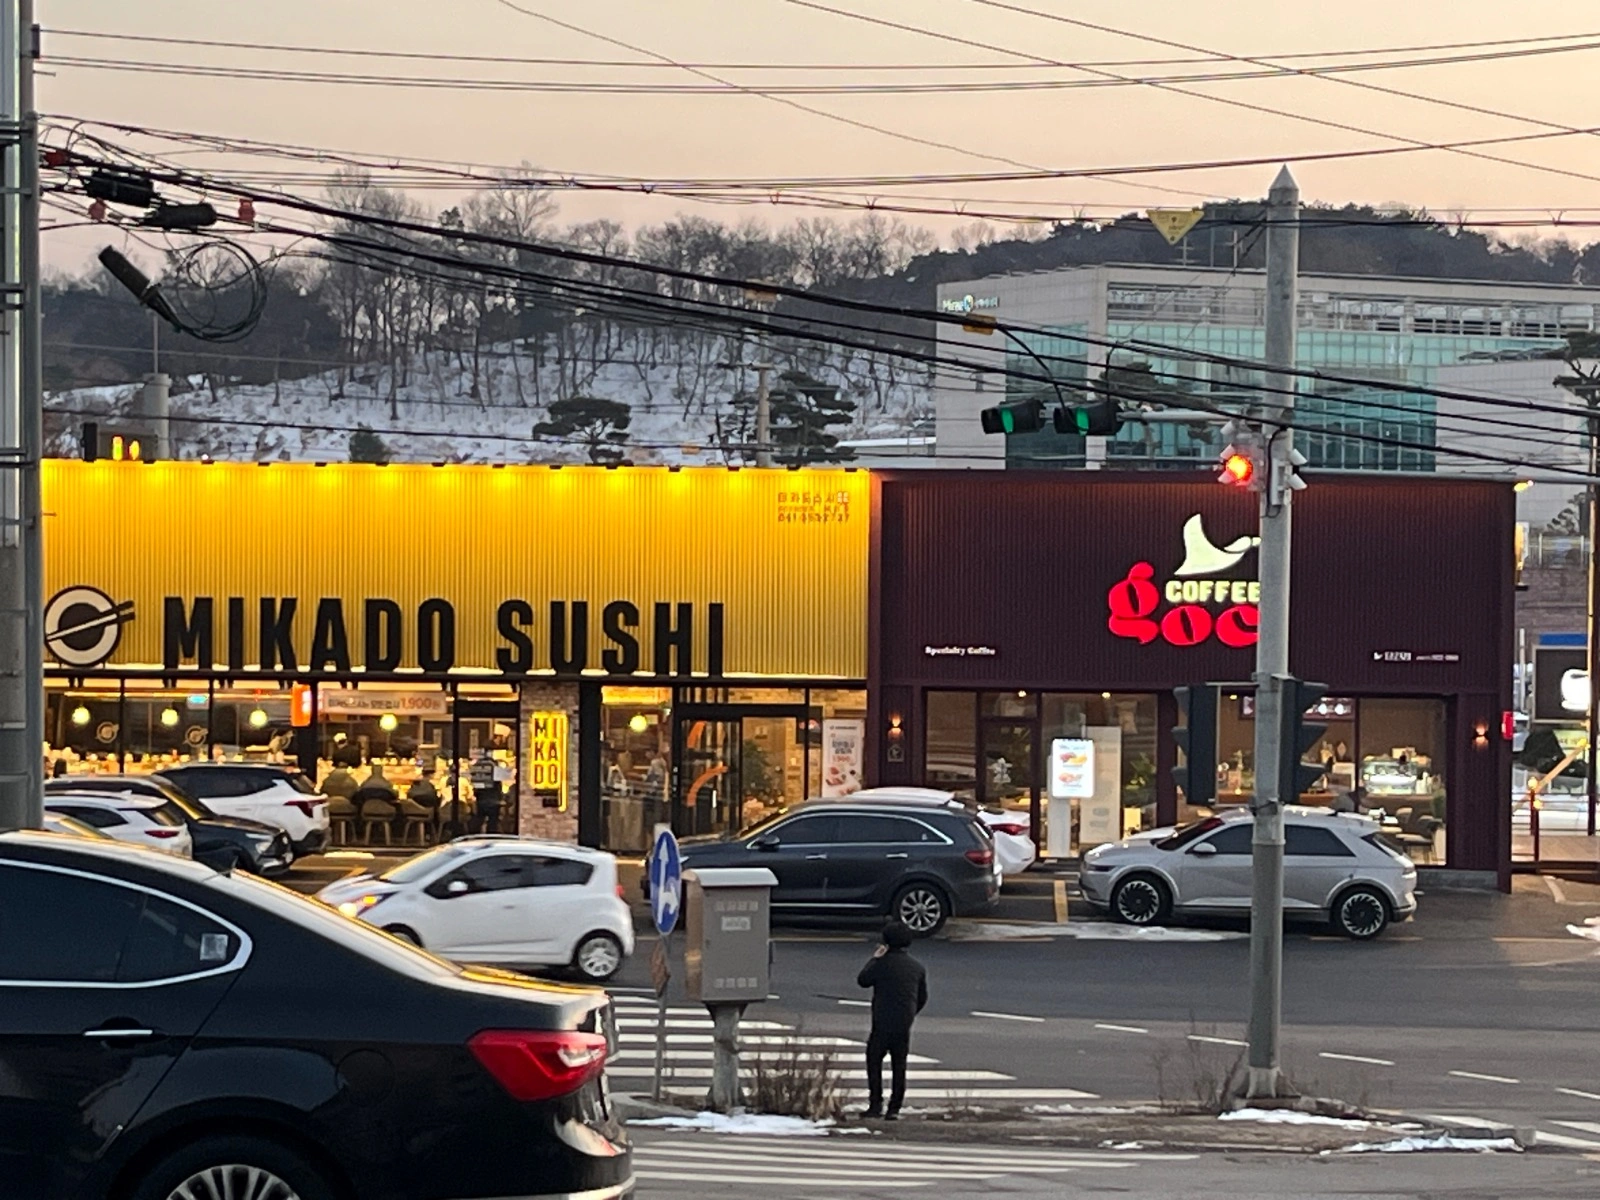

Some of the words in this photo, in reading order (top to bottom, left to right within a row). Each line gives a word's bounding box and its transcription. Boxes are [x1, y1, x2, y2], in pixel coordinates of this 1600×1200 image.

[1165, 580, 1261, 604] COFFEE
[163, 596, 456, 673] MIKADO
[496, 599, 724, 677] SUSHI
[534, 718, 558, 738] MI
[534, 741, 558, 761] KA
[534, 764, 558, 785] DO
